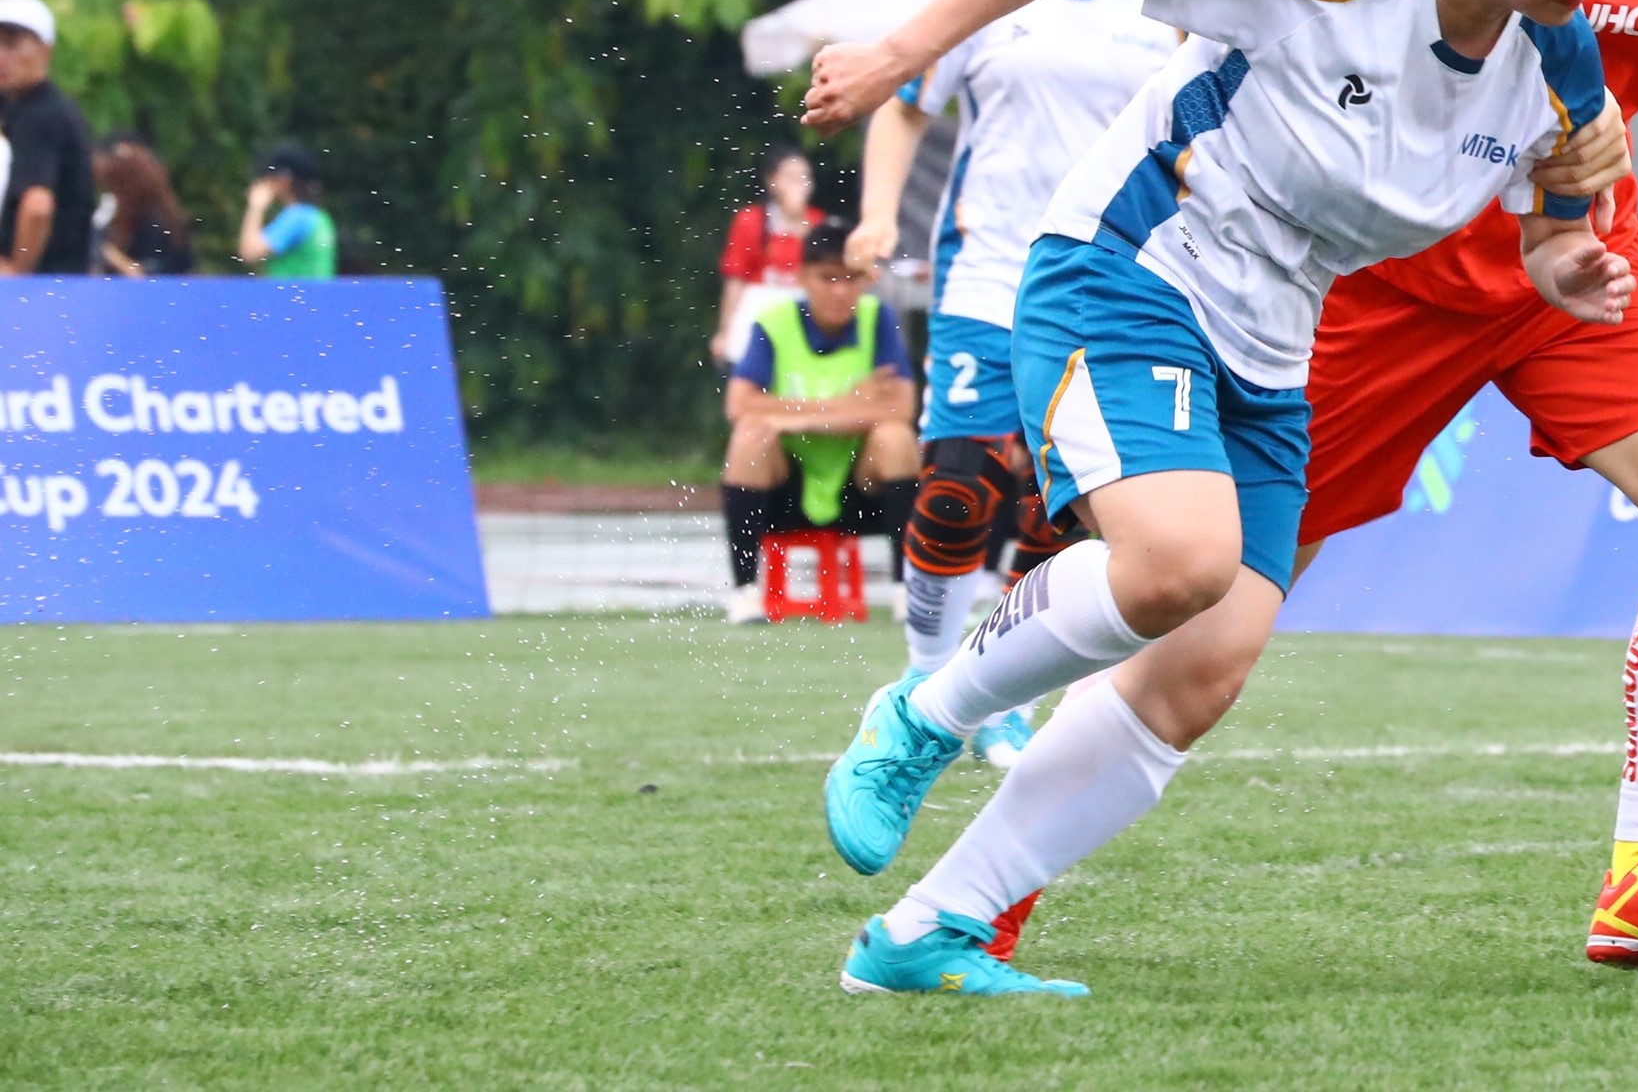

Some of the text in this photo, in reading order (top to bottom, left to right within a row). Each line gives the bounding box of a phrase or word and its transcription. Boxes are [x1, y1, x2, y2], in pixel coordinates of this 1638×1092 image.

[1458, 133, 1520, 168] MiTek
[1182, 241, 1200, 260] MAX
[0, 373, 404, 434] rd Chartered
[948, 352, 979, 404] 2
[1151, 365, 1192, 431] 7
[0, 458, 259, 534] up 2024
